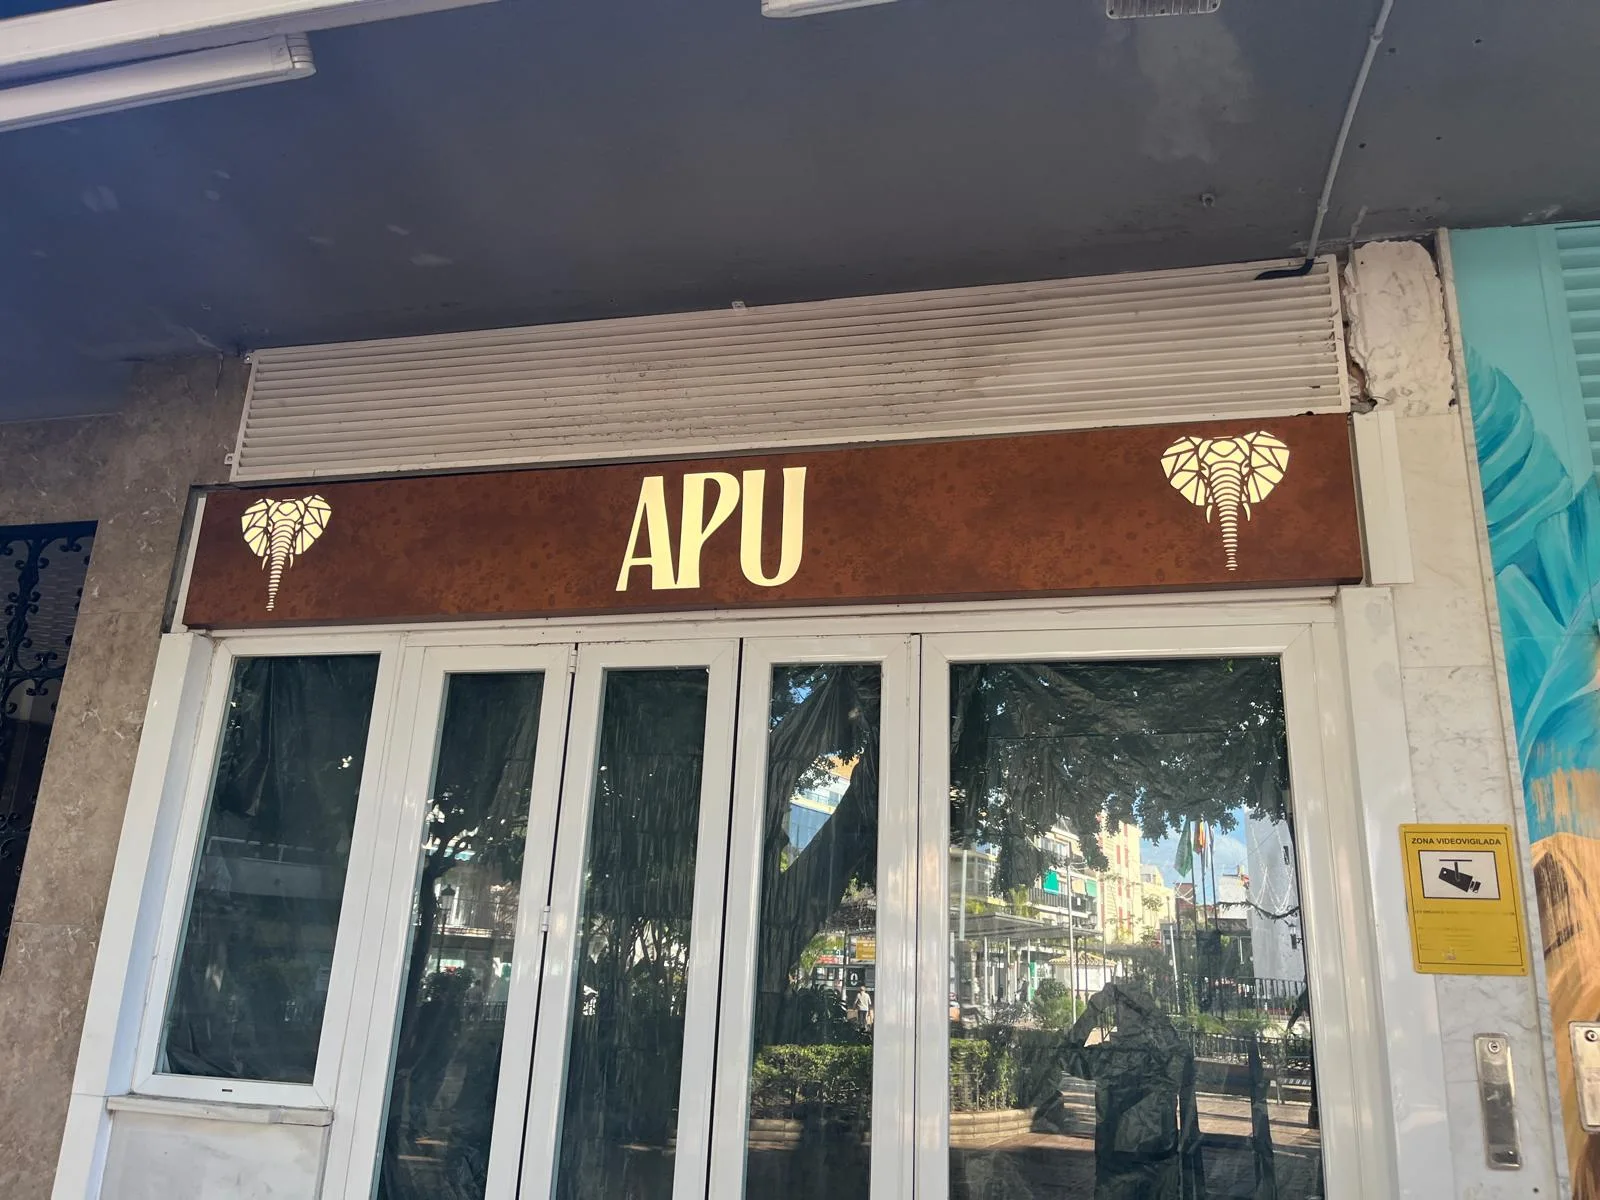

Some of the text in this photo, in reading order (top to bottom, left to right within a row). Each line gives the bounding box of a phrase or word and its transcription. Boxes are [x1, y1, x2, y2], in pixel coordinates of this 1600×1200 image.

[615, 466, 807, 592] APU
[1411, 837, 1502, 846] ZONA VIDEOVIGILADA
